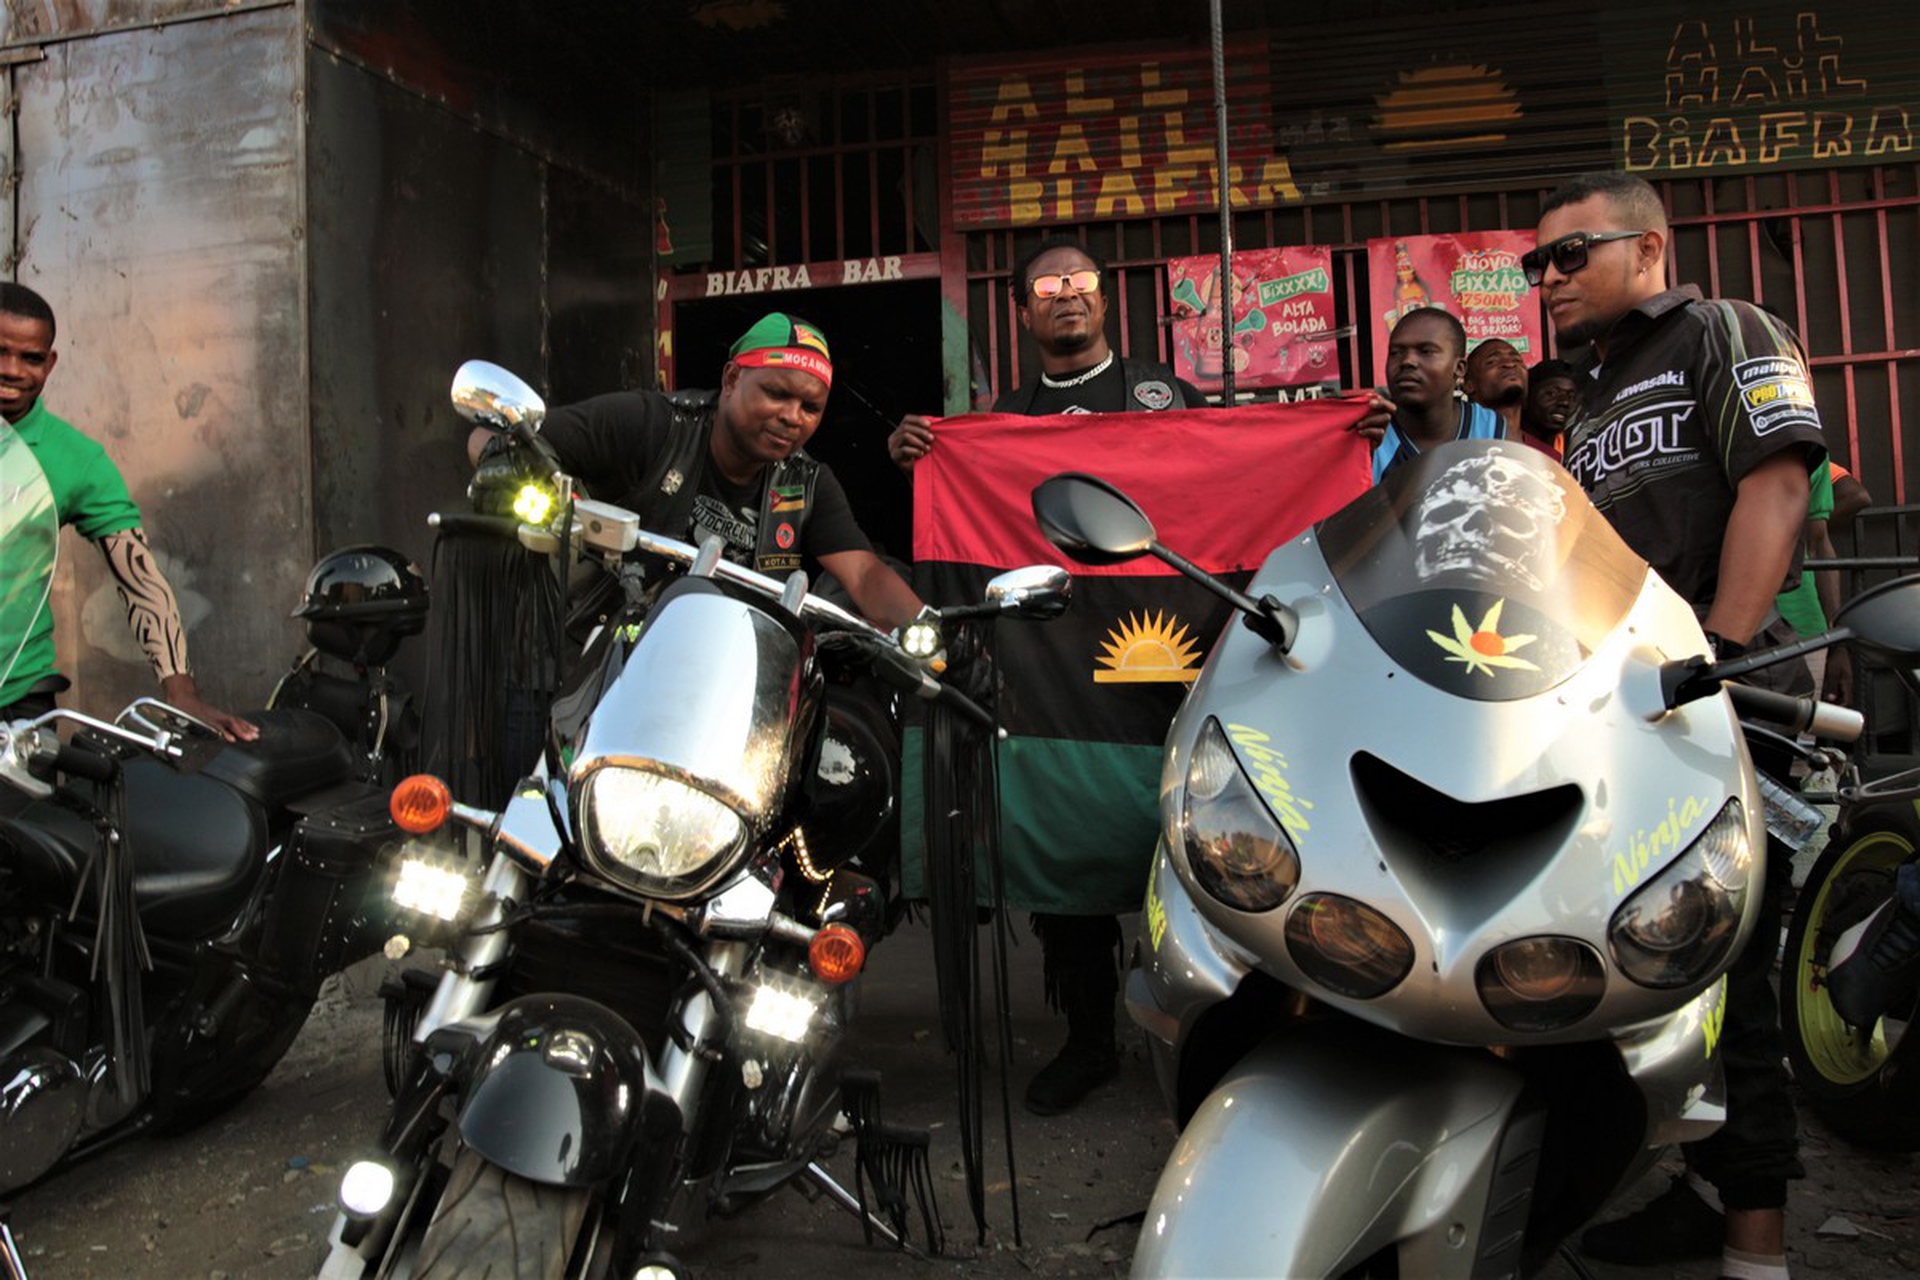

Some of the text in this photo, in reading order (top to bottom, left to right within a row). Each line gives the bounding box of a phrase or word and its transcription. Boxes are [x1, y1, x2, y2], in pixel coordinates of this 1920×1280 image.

[1665, 12, 1843, 70] ALL
[990, 61, 1189, 121] ALL
[980, 111, 1216, 178] HAIL
[1008, 156, 1303, 225] BIAFRA
[705, 255, 903, 297] BIAFRA BAR
[1271, 315, 1328, 338] BOLADA
[1282, 299, 1315, 318] ALTA
[1227, 723, 1314, 844] Ninja
[1611, 796, 1710, 897] Ninja
